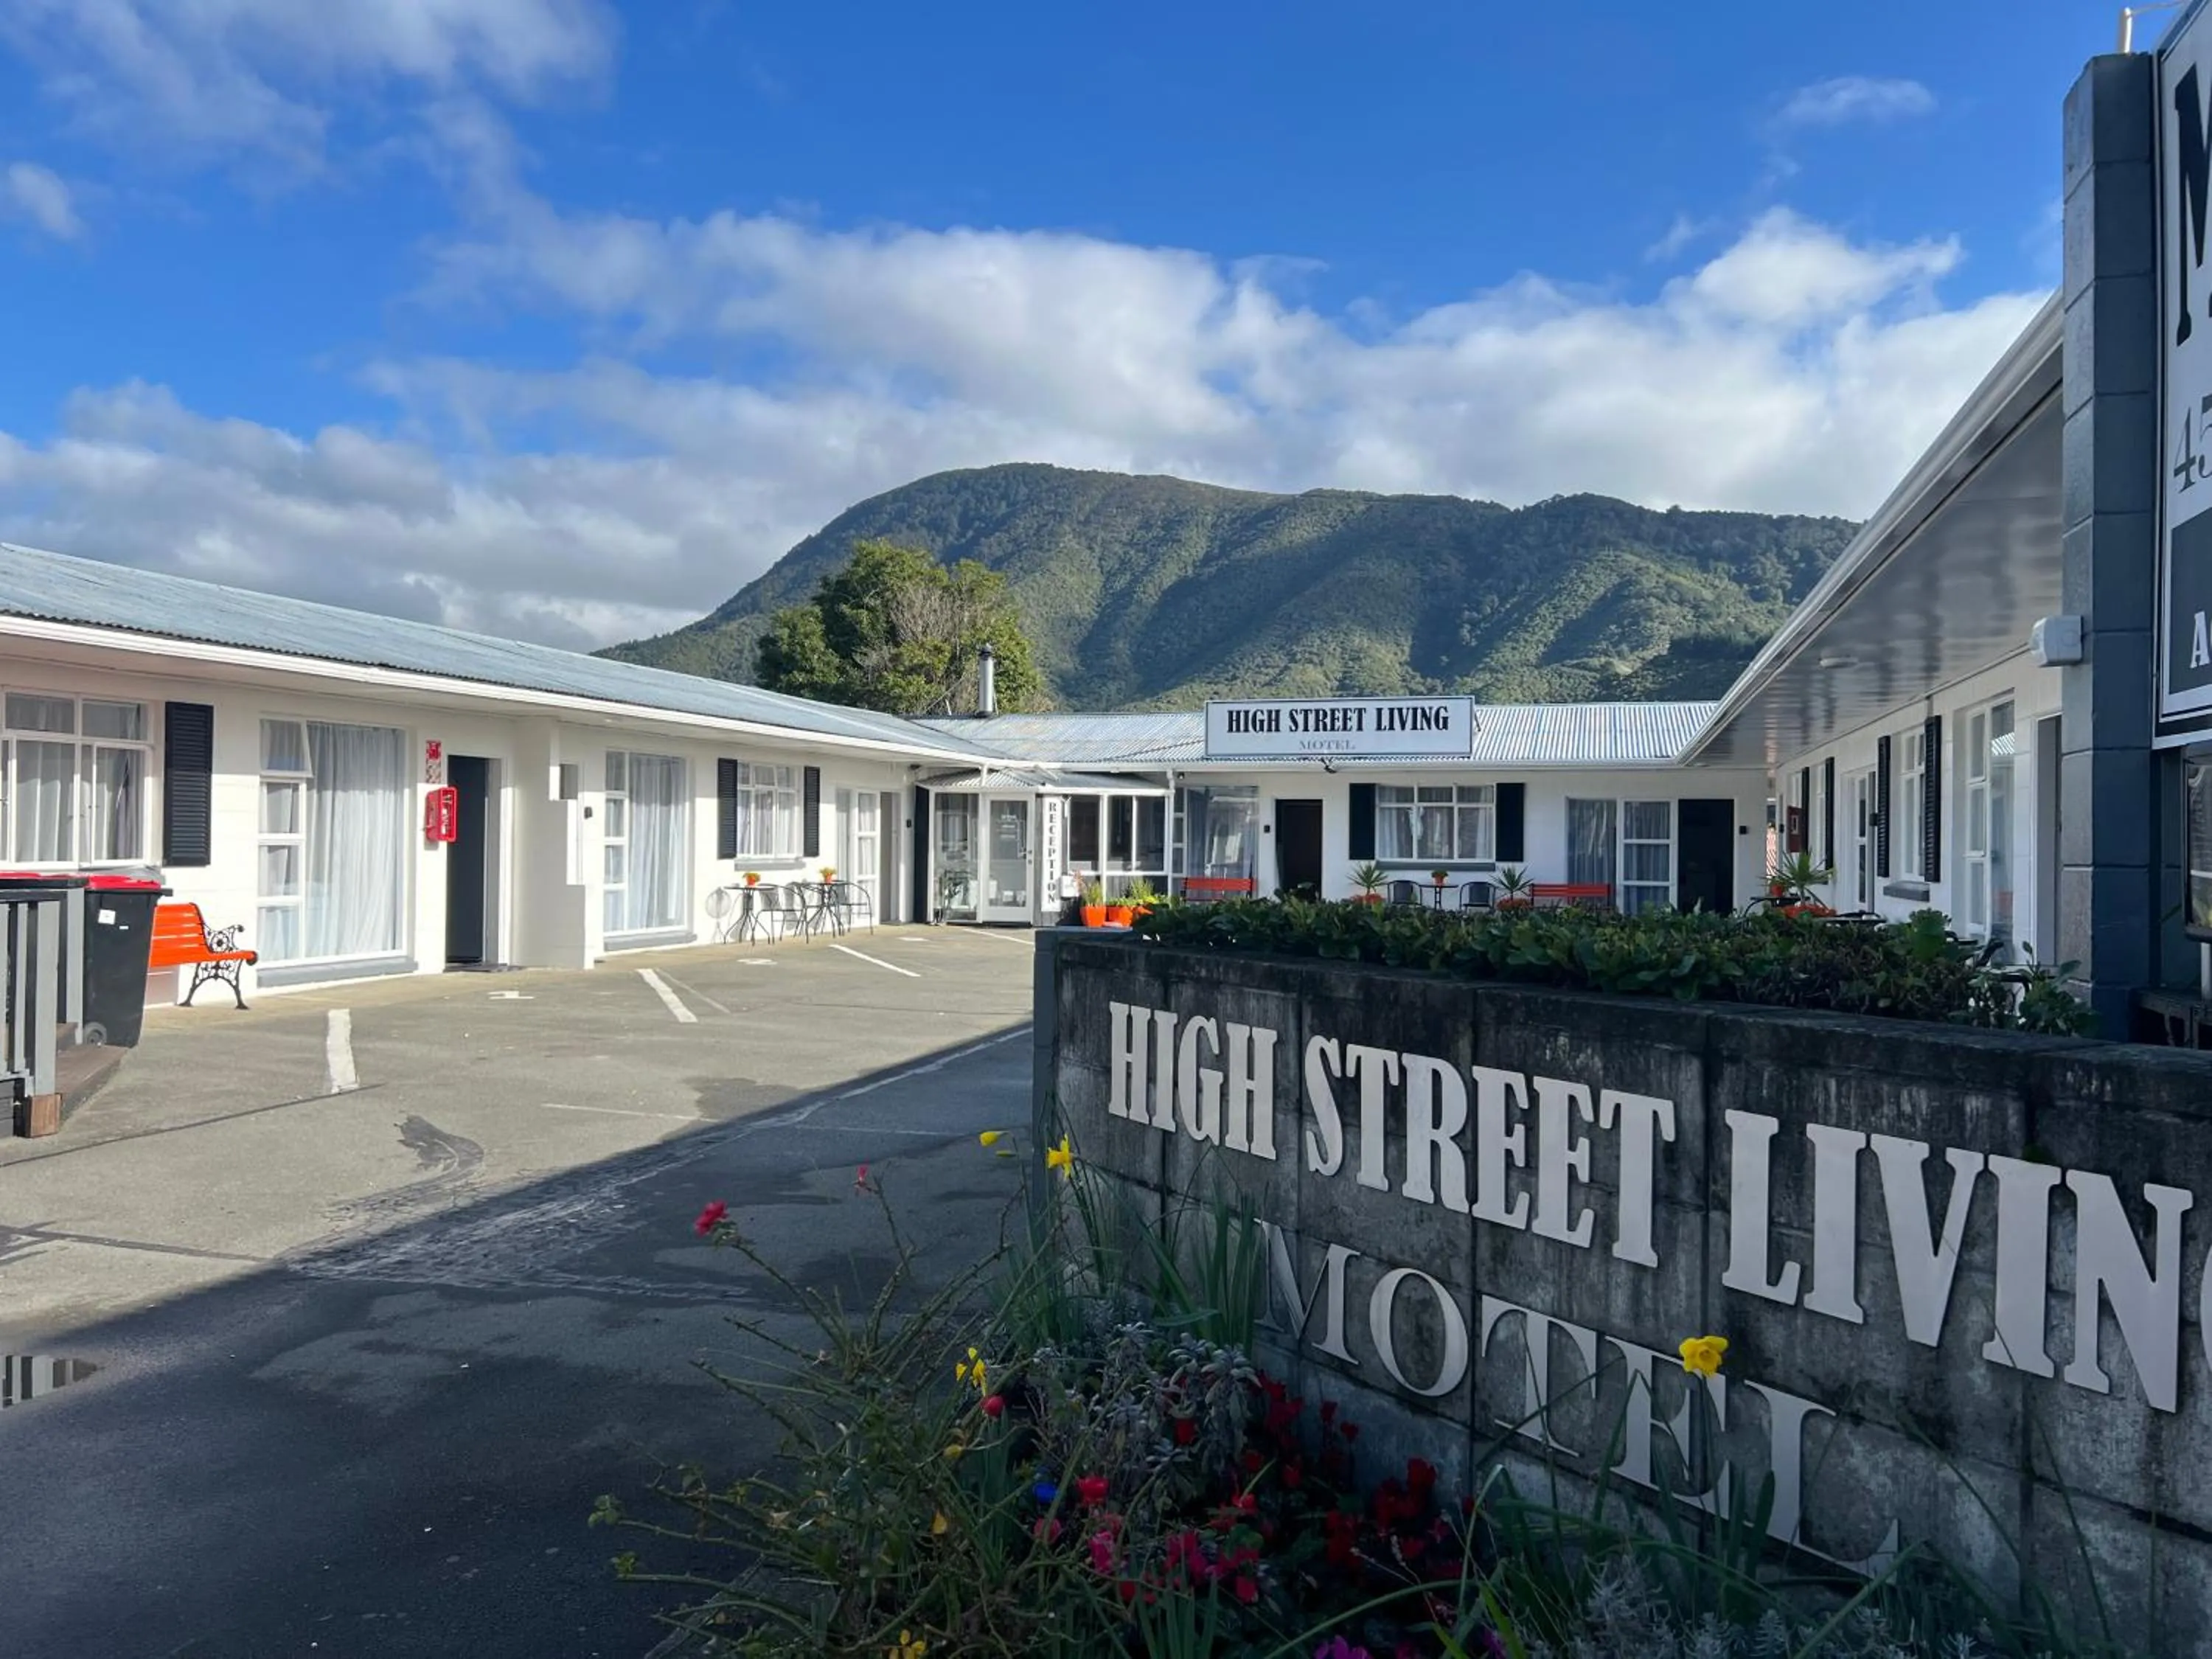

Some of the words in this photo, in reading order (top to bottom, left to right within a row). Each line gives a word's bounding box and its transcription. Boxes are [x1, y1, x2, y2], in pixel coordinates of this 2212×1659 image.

[1227, 709, 1281, 734] HIGH
[1289, 707, 1366, 733] STREET
[1374, 706, 1450, 731] LIVING
[1298, 739, 1355, 751] MOTEL
[1048, 801, 1057, 904] RECEPTION
[1108, 1001, 1278, 1161] HIGH
[1304, 1034, 1675, 1269] STREET
[1722, 1108, 2212, 1413] LIVIN
[1253, 1217, 1899, 1585] MOTEL
